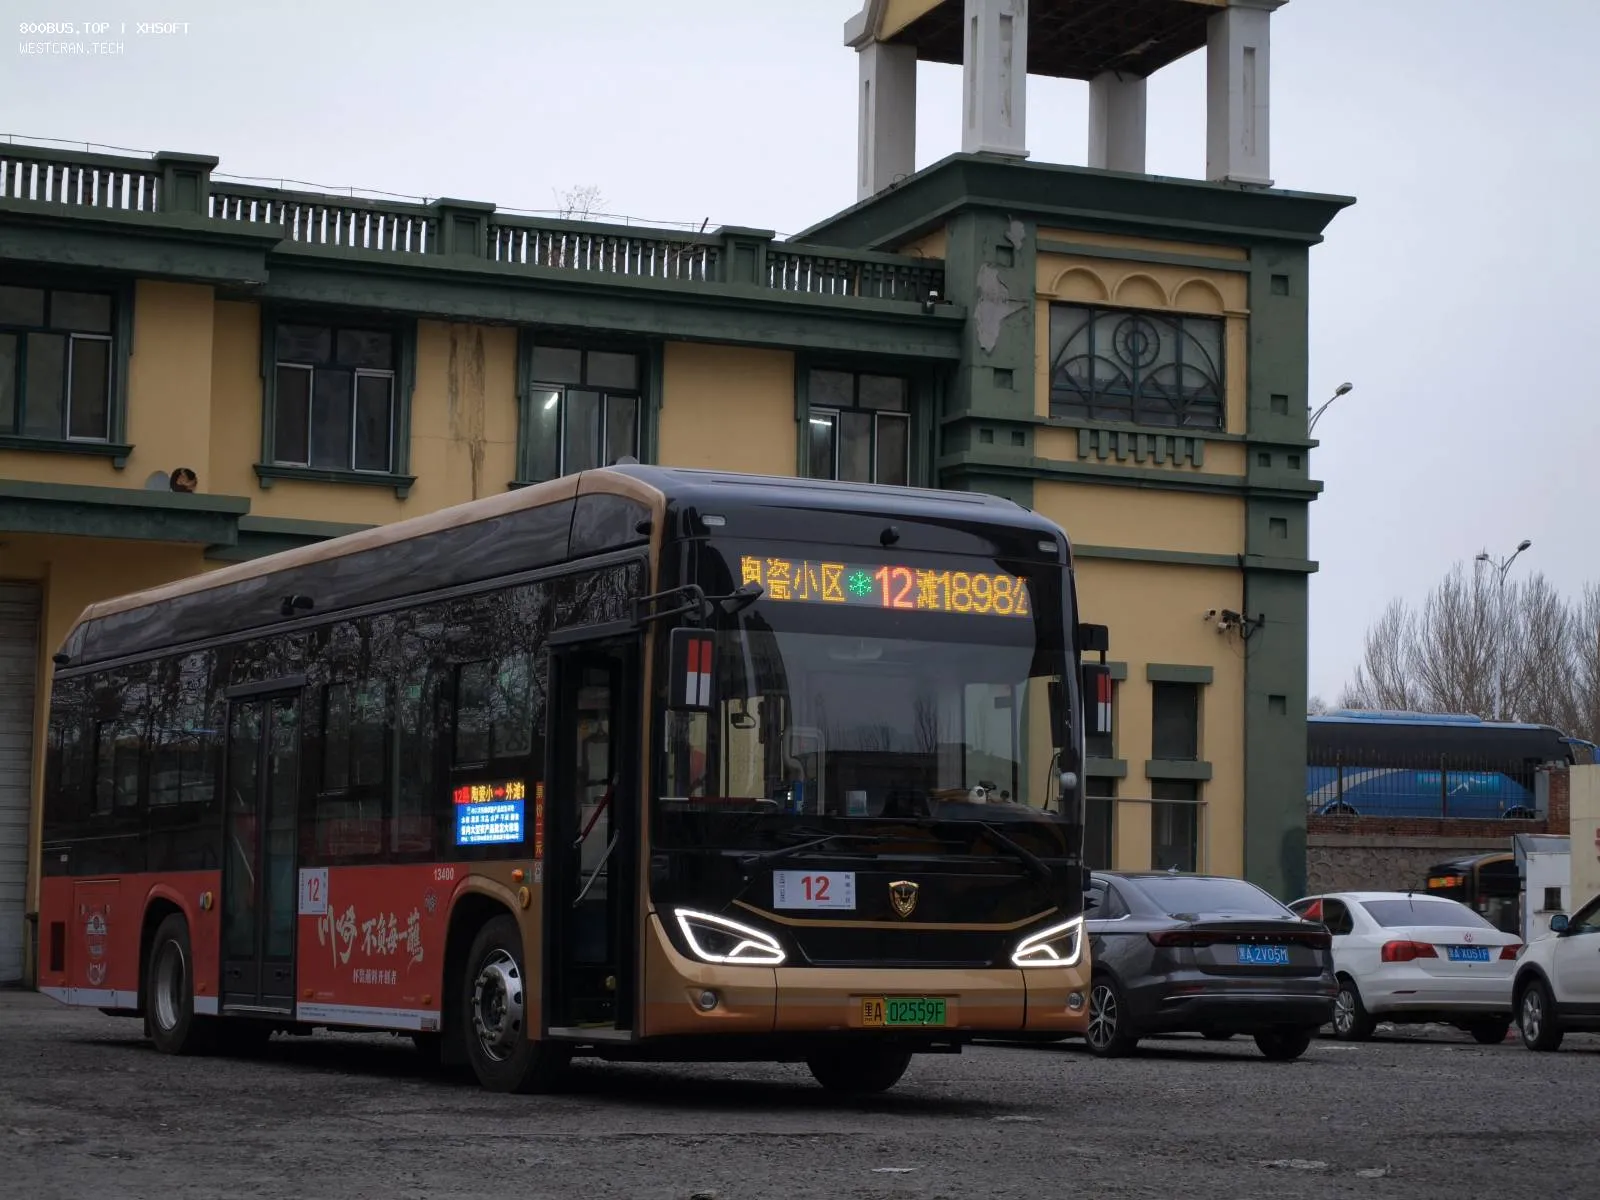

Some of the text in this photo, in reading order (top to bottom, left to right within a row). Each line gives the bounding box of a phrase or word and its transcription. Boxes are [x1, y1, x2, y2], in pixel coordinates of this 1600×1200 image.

[875, 565, 914, 609] 12
[434, 867, 454, 881] 13400
[307, 877, 321, 902] 12
[801, 875, 831, 902] 12
